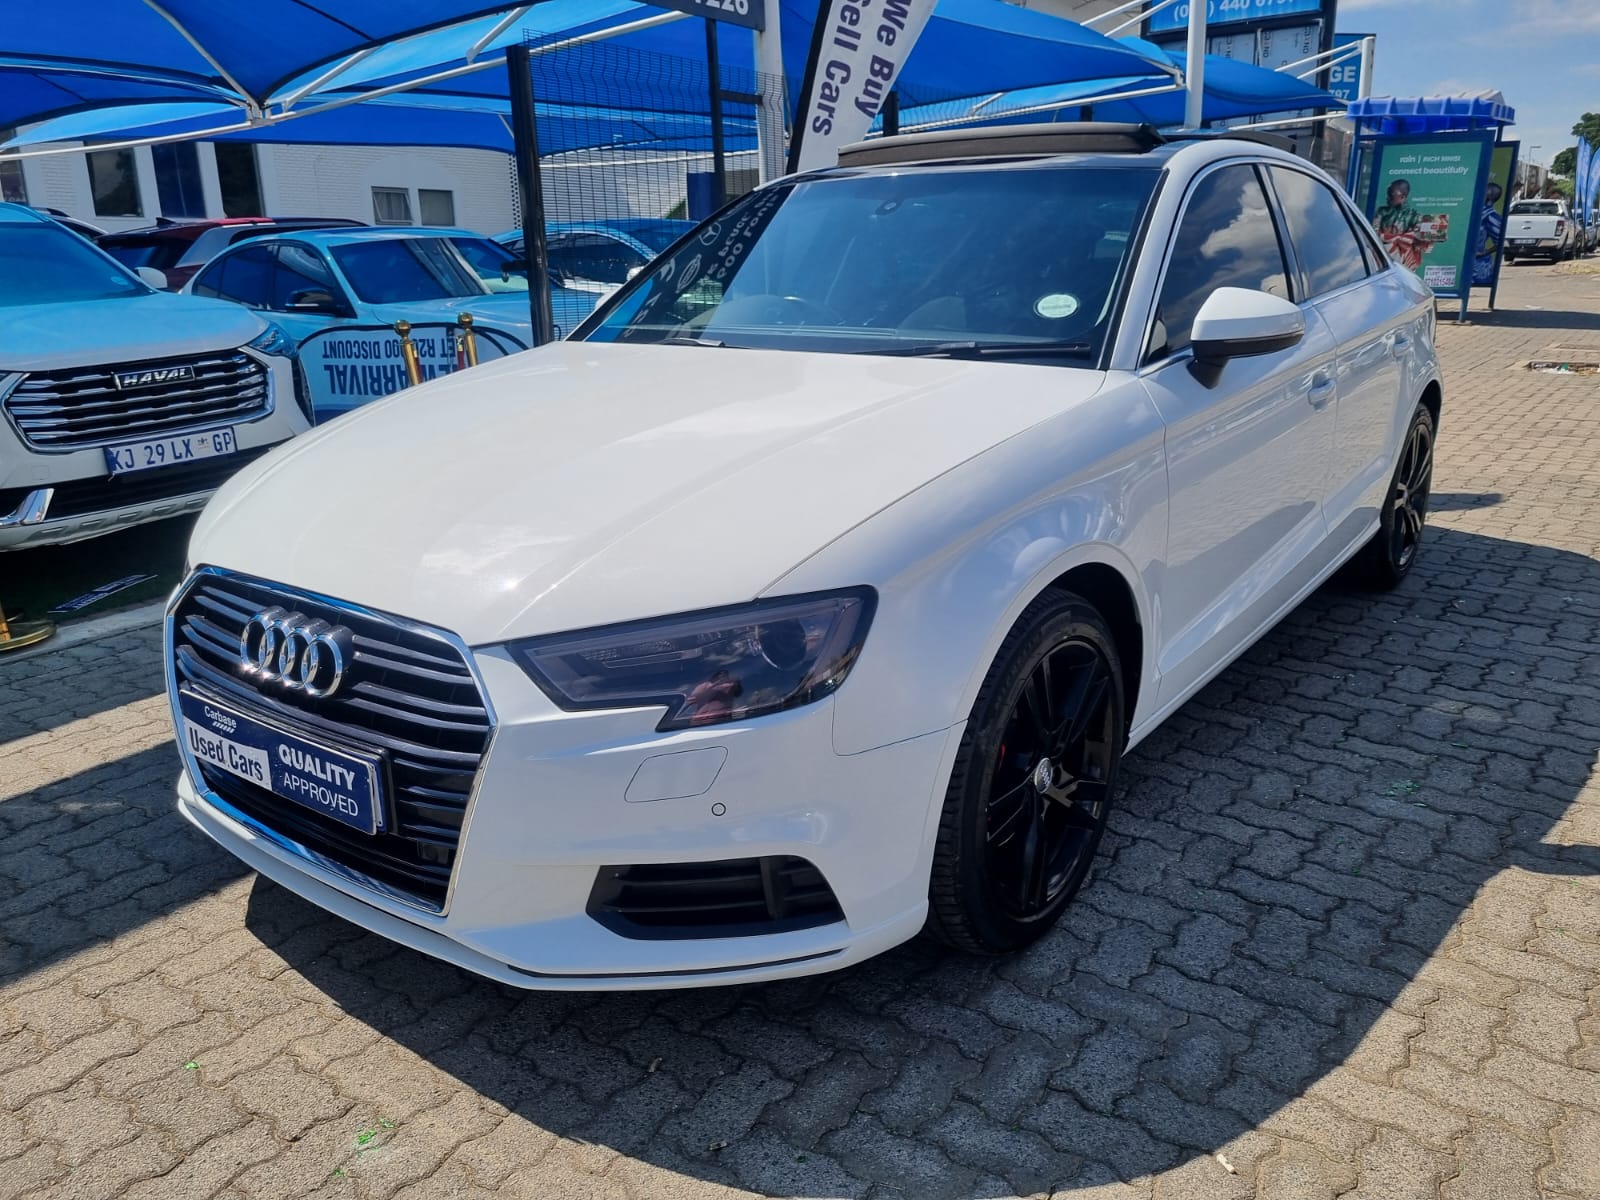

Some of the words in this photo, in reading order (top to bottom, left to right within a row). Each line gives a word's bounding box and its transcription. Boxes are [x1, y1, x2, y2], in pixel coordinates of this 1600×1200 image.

[834, 0, 871, 52] ell
[877, 0, 912, 46] We
[1174, 1, 1215, 22] (0)
[1219, 0, 1250, 11] 440
[812, 59, 851, 136] Cars
[855, 54, 895, 119] Buy
[1389, 167, 1422, 175] connect
[1423, 166, 1469, 176] beautifully
[322, 339, 381, 360] DISCOUNT
[440, 338, 457, 358] ET
[123, 367, 192, 386] HAVAL
[323, 364, 408, 396] ARRIVAL
[112, 449, 135, 472] KJ
[144, 444, 165, 465] 29
[171, 438, 194, 460] LX
[212, 432, 232, 453] GP
[204, 706, 237, 729] Carbase
[189, 727, 225, 763] Used
[228, 745, 264, 782] Cars
[278, 743, 356, 791] QUALITY
[284, 774, 359, 817] APPROVED
